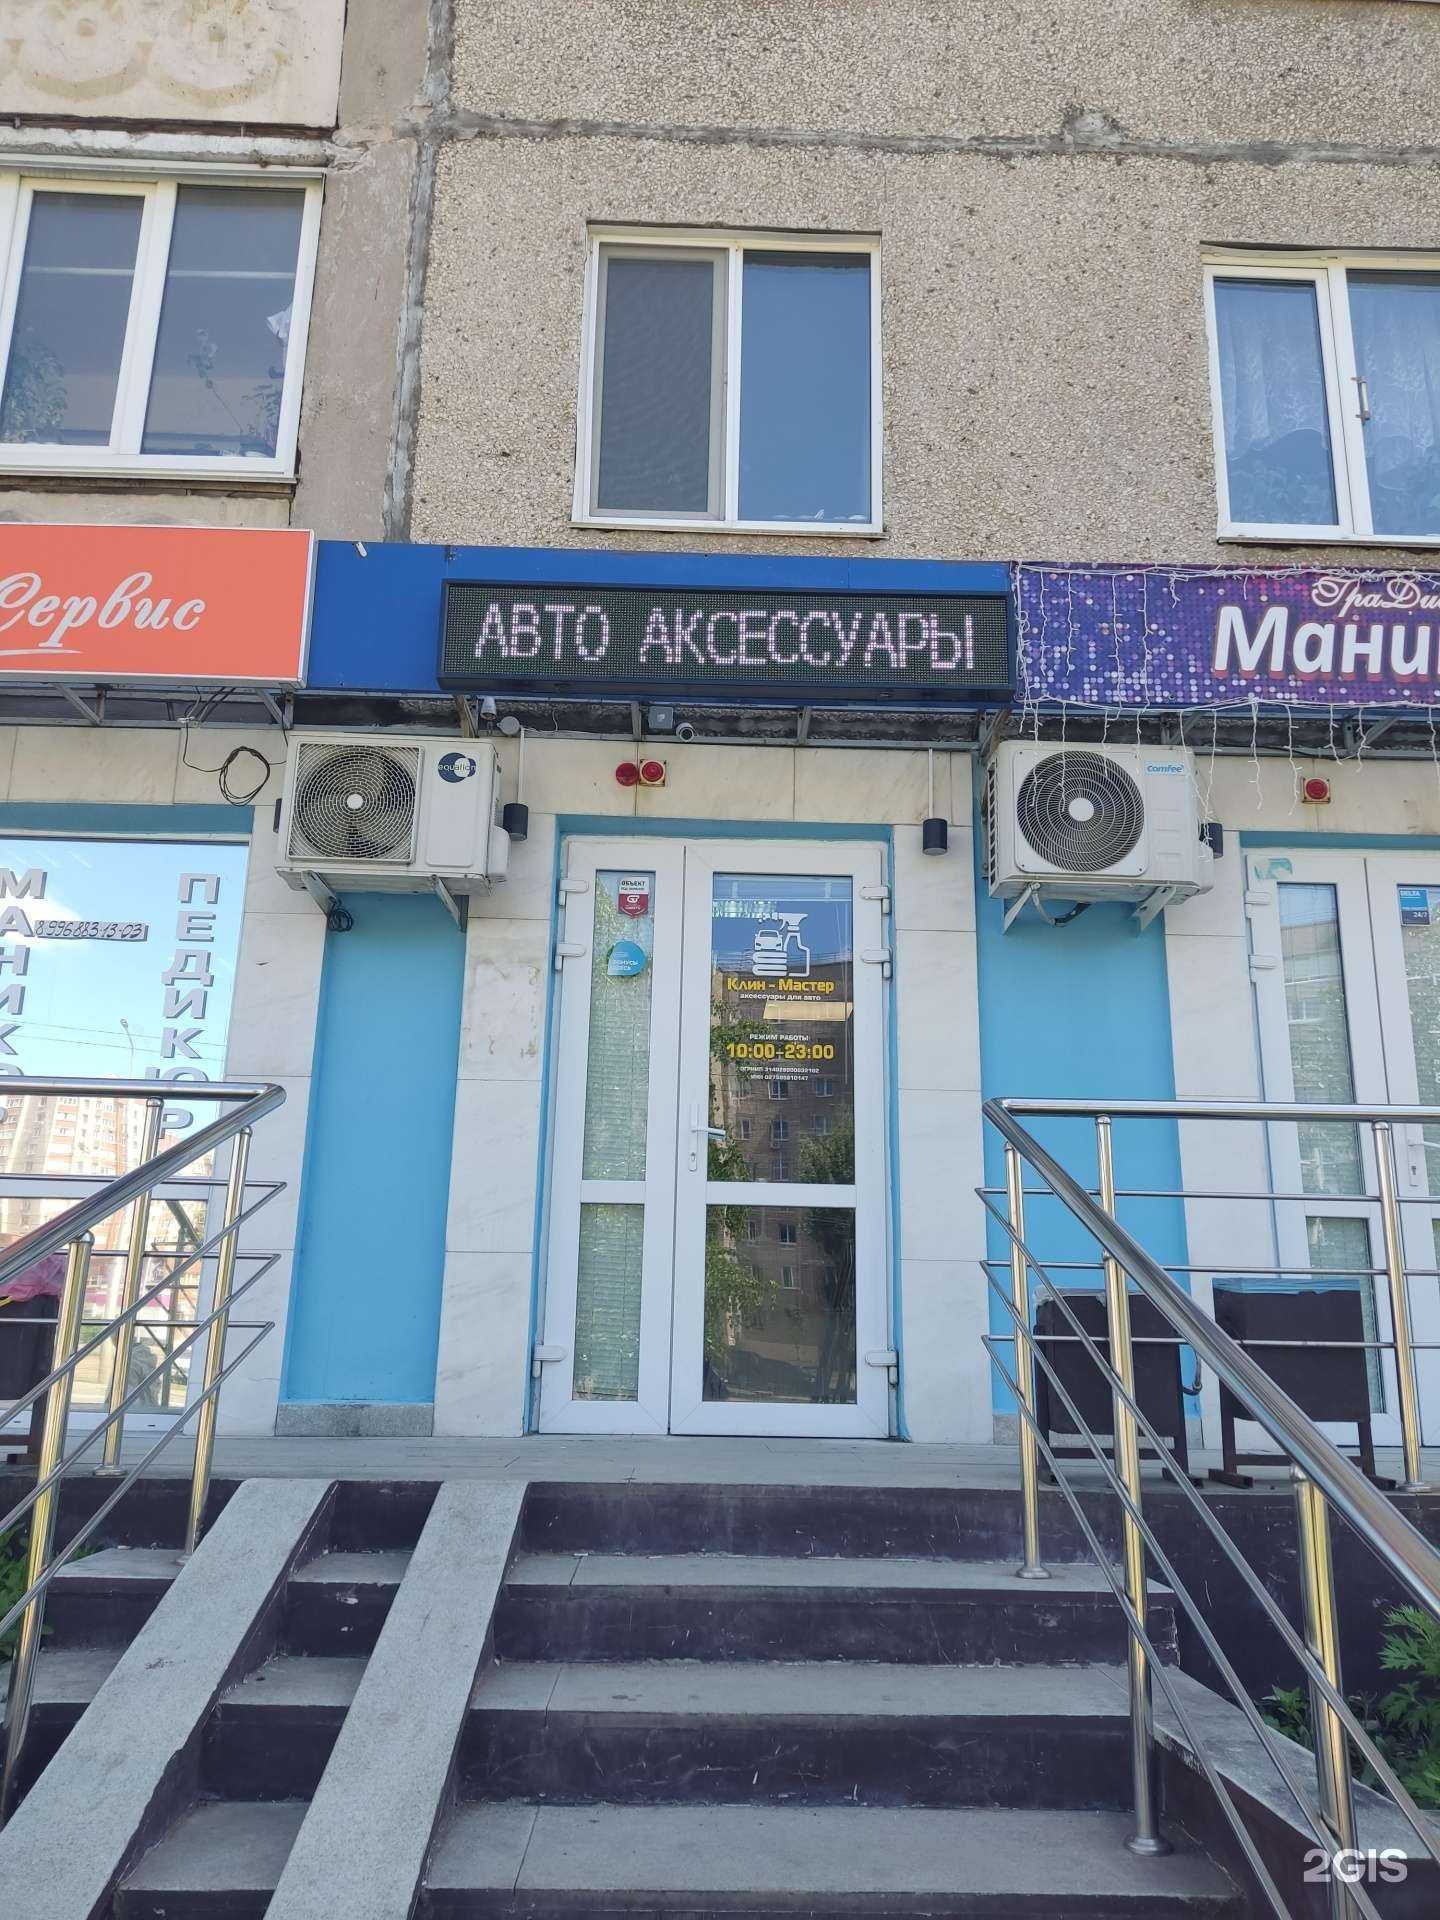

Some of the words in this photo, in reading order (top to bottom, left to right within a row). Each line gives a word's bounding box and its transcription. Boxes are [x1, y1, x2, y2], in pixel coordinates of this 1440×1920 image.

[0, 572, 206, 648] Сервис
[474, 603, 610, 662] АВТО
[639, 607, 975, 670] АКСЕССУАРЫ
[1213, 606, 1440, 675] Мани
[727, 977, 766, 991] Клин
[778, 978, 835, 994] Мастер
[740, 993, 786, 1001] аксессуары
[726, 1043, 834, 1059] 10:00-23:00
